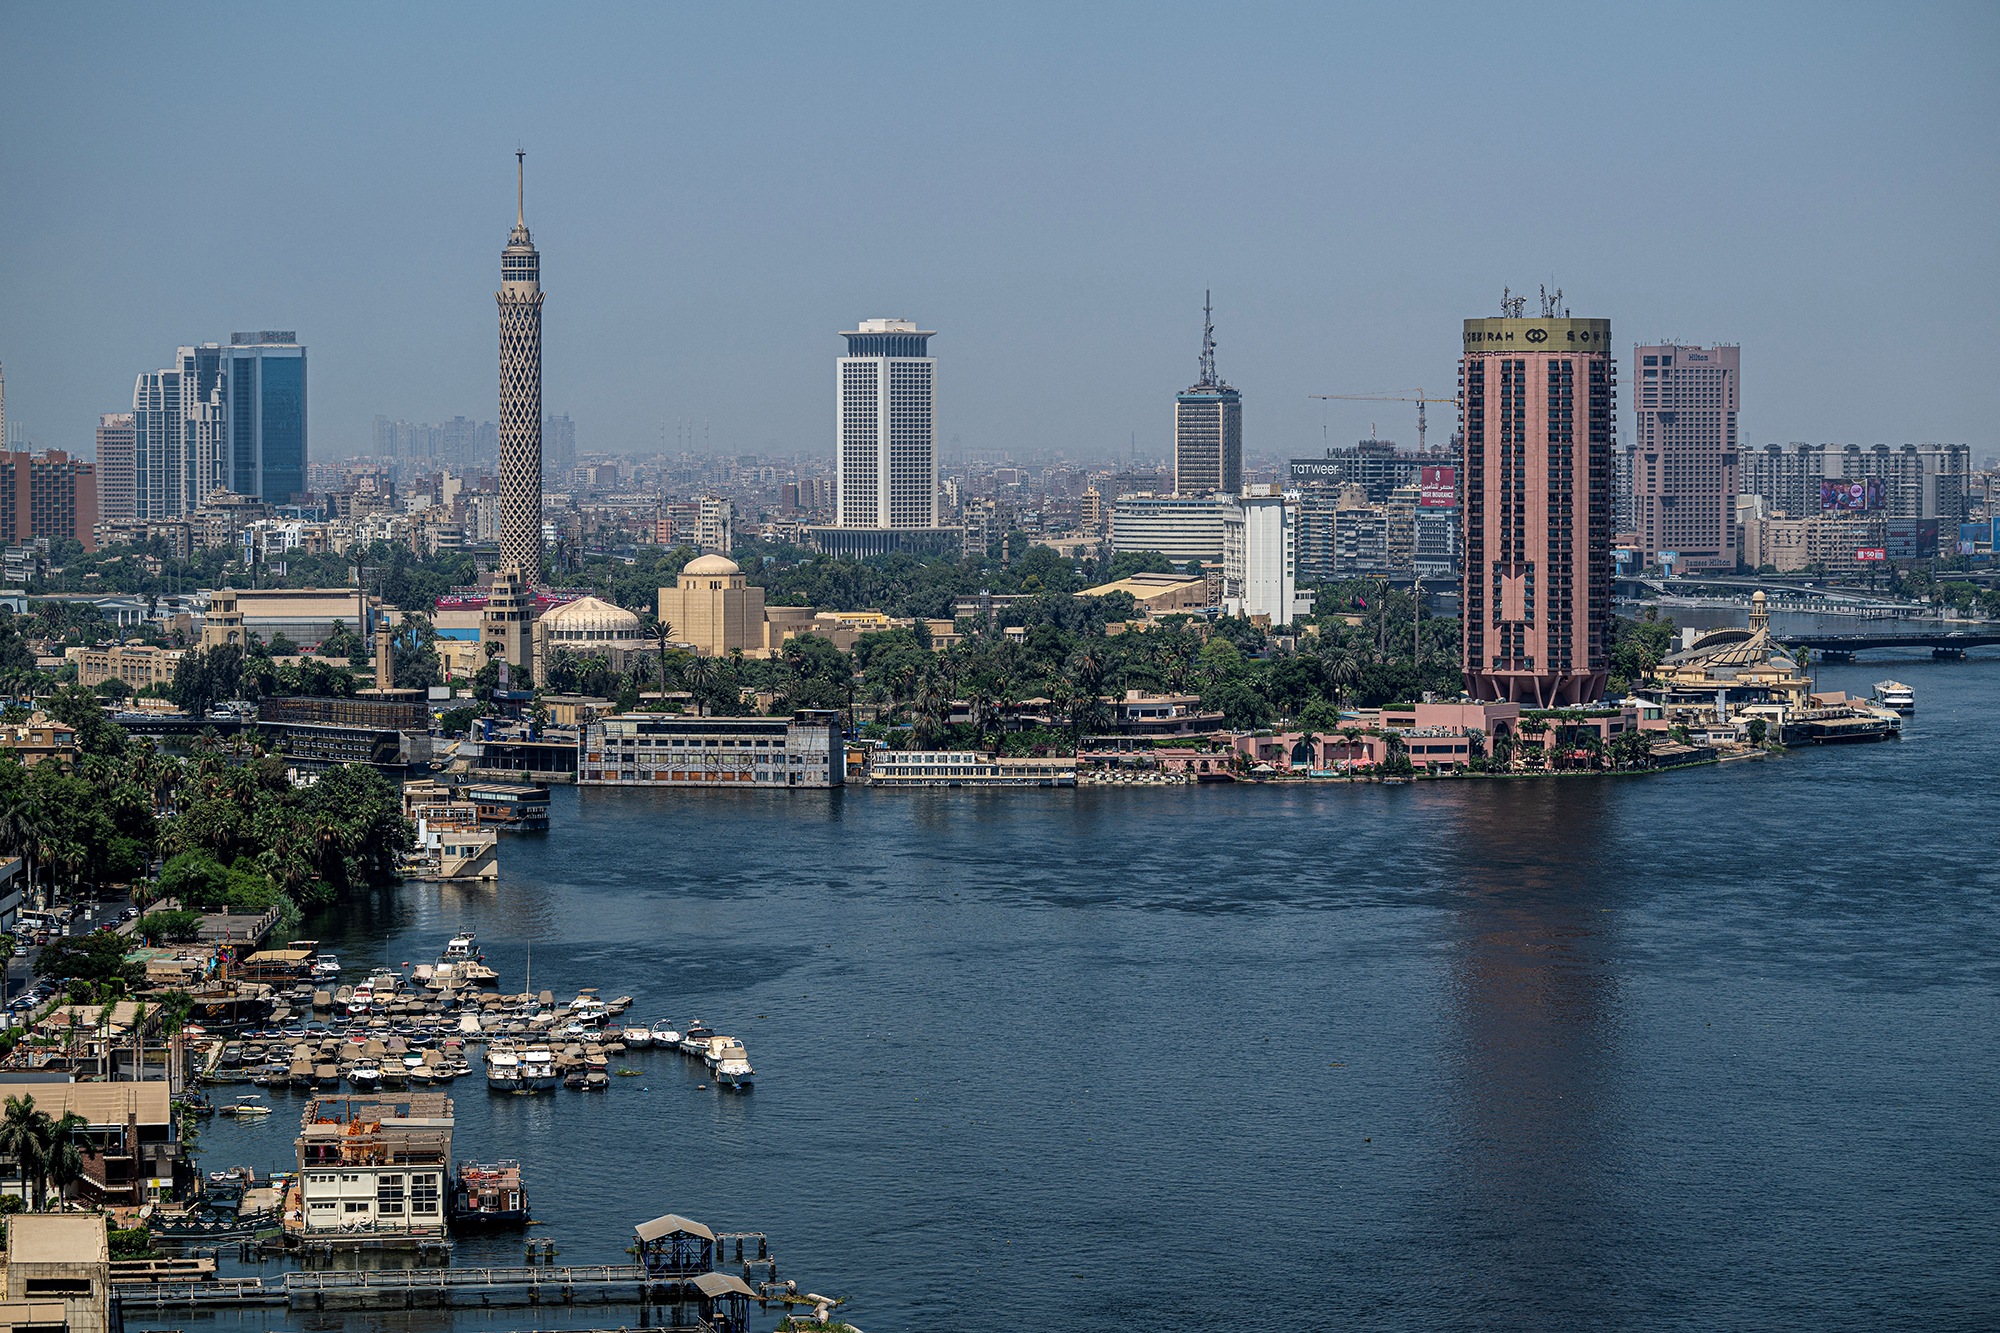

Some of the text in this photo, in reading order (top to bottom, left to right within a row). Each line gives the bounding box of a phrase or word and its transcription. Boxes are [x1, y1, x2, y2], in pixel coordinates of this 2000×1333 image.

[1688, 353, 1709, 361] Hilton
[1432, 491, 1454, 499] INSURANCE
[1709, 558, 1731, 567] Hilton
